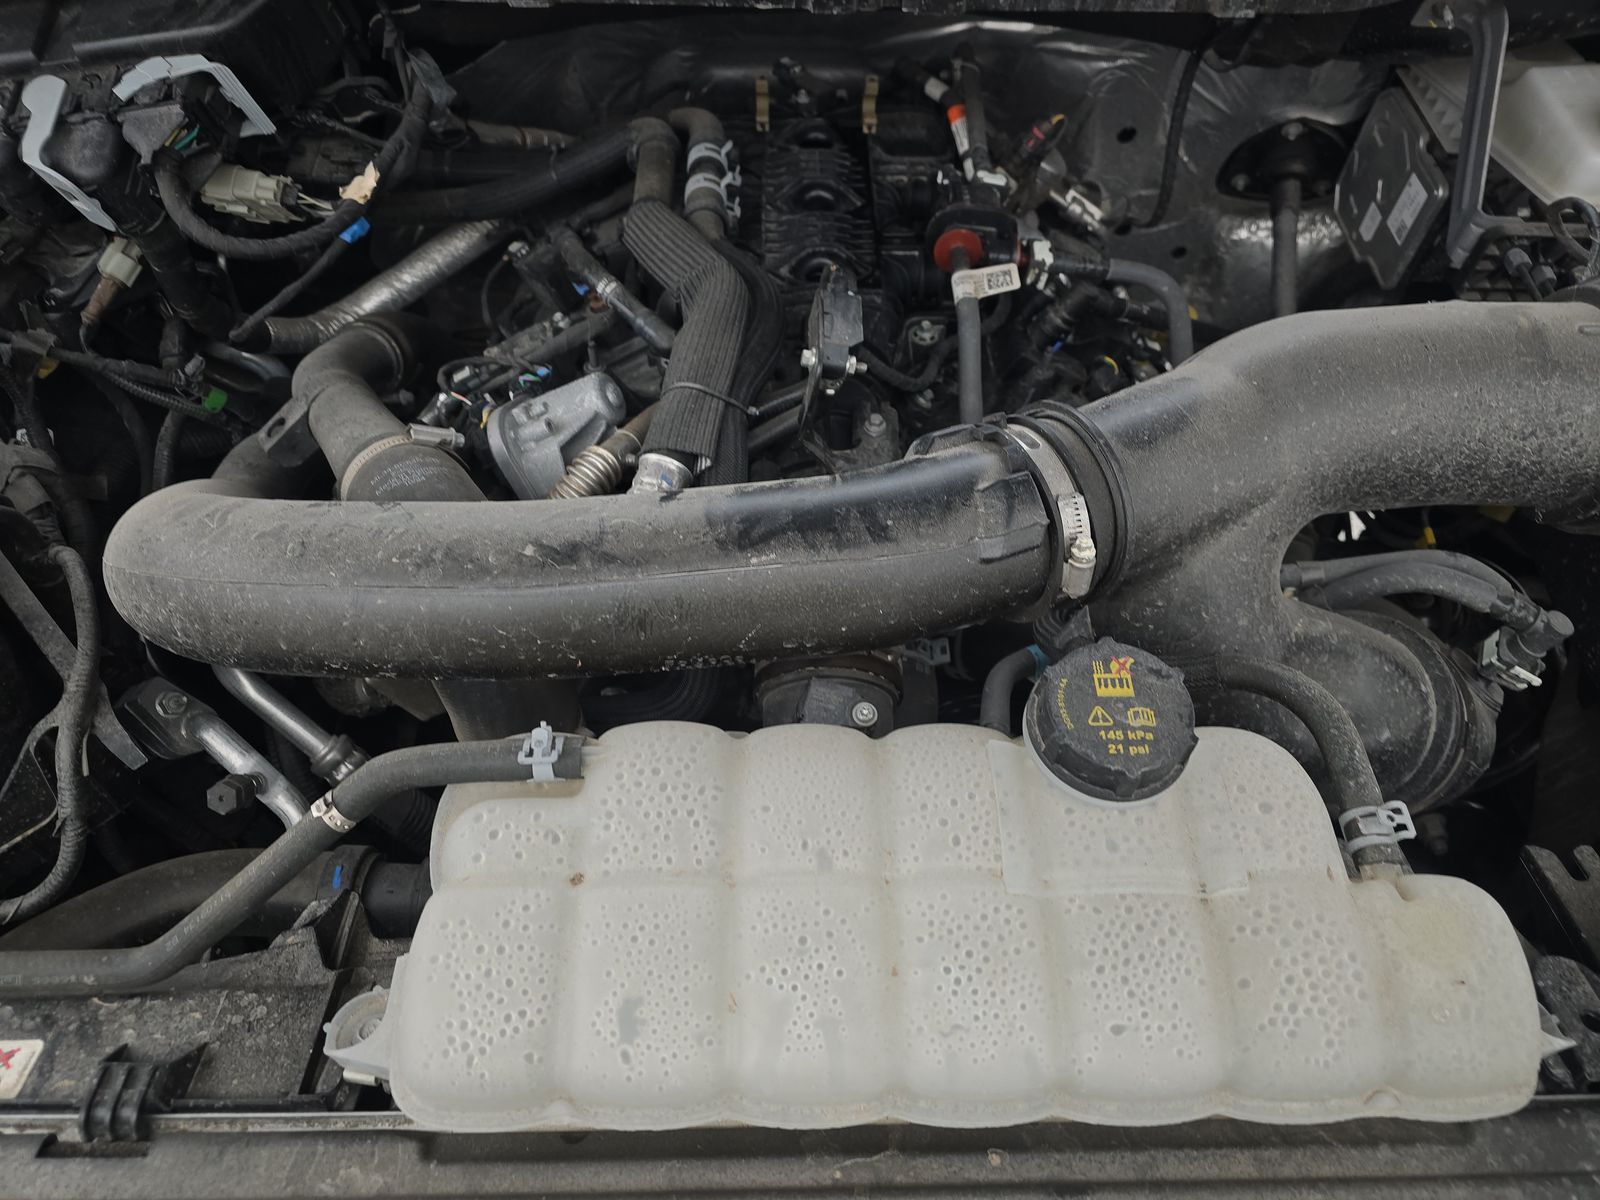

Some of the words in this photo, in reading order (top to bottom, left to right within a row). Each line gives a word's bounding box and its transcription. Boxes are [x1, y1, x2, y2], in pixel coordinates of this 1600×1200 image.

[1099, 729, 1124, 740] 145
[1127, 729, 1154, 740] kPa
[1108, 743, 1124, 754] 21
[1129, 743, 1150, 756] psi
